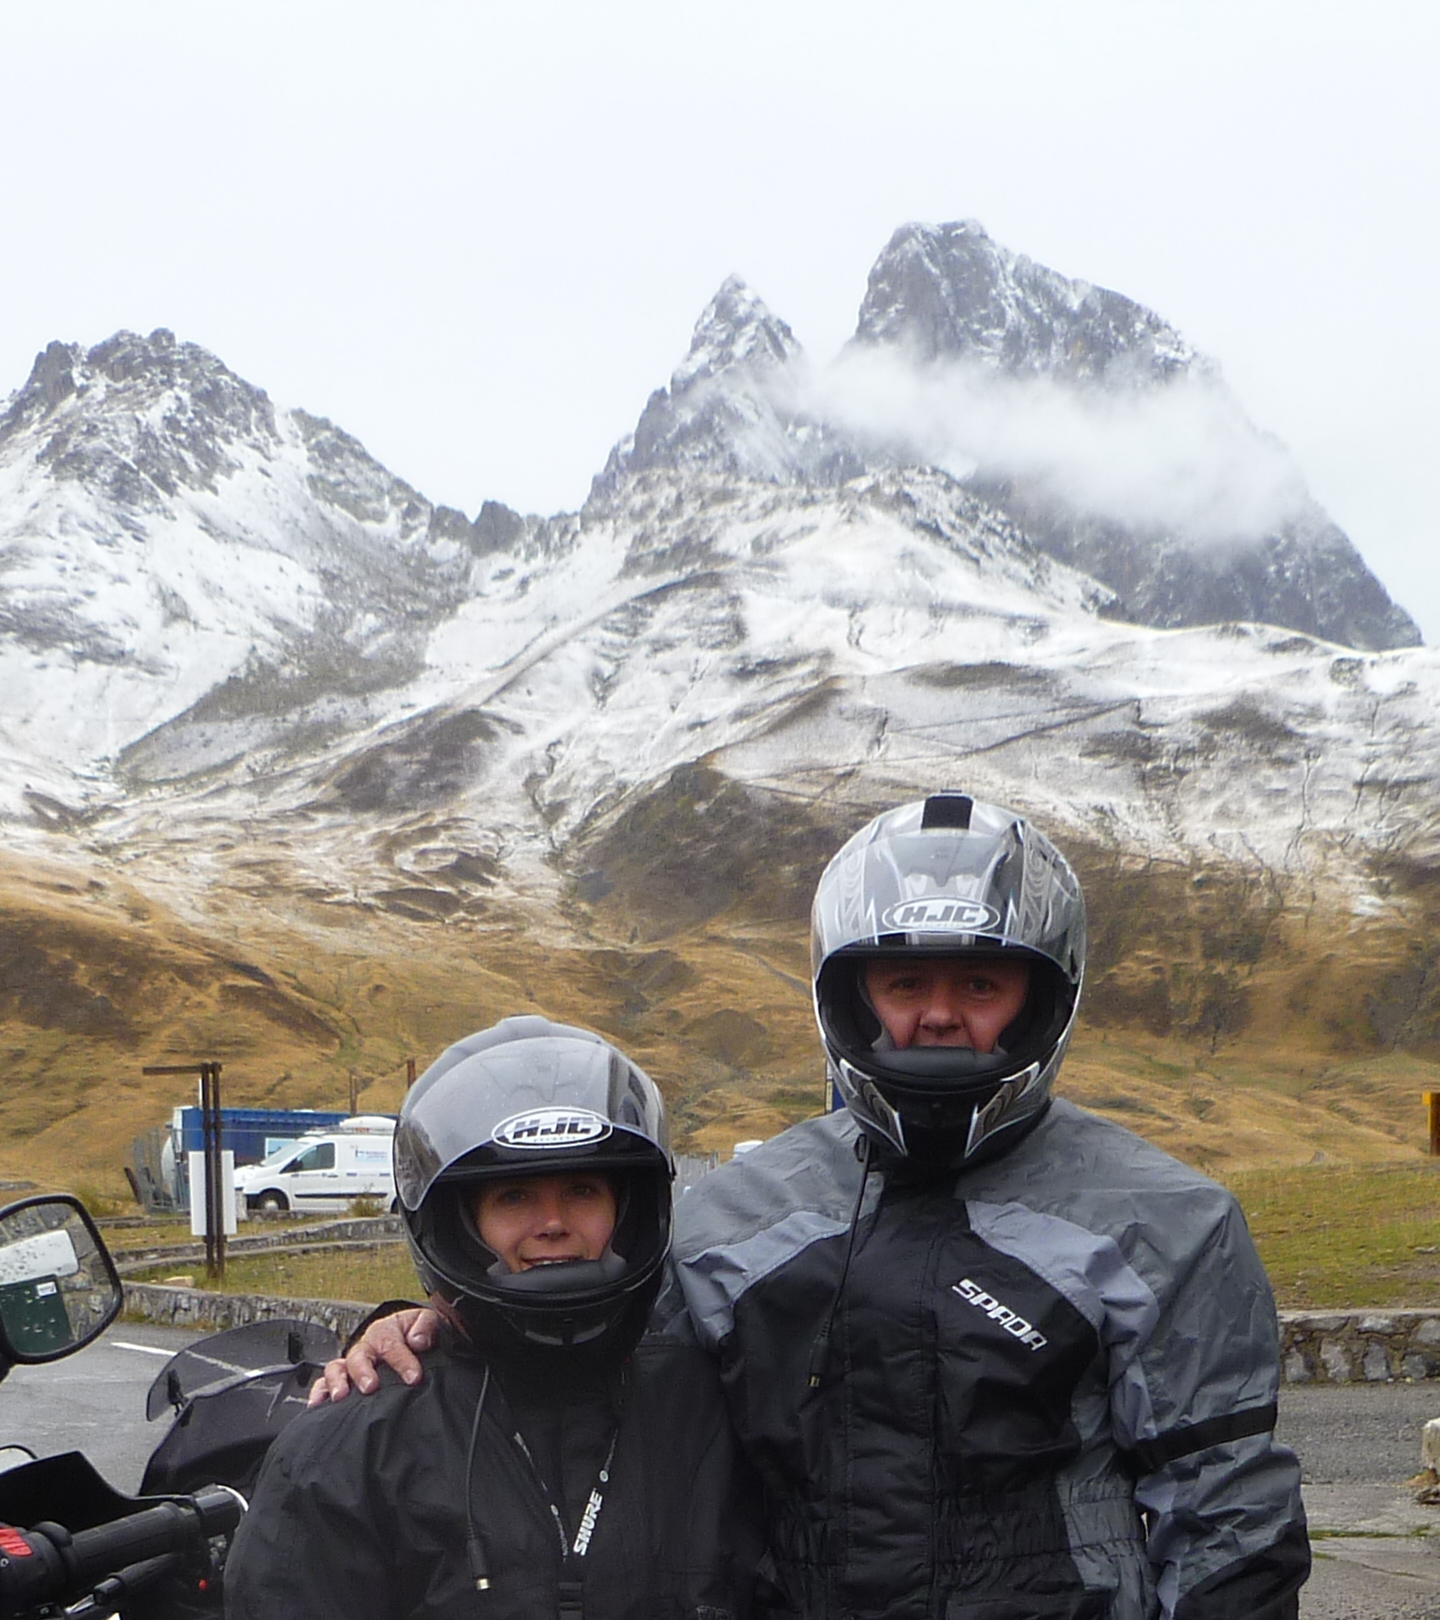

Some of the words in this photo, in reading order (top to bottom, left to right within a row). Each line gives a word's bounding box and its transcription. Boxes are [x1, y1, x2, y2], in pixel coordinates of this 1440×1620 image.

[900, 905, 981, 924] HJC
[512, 1116, 595, 1140] HJC
[951, 1278, 1049, 1352] SPADA
[573, 1490, 603, 1556] SHURE
